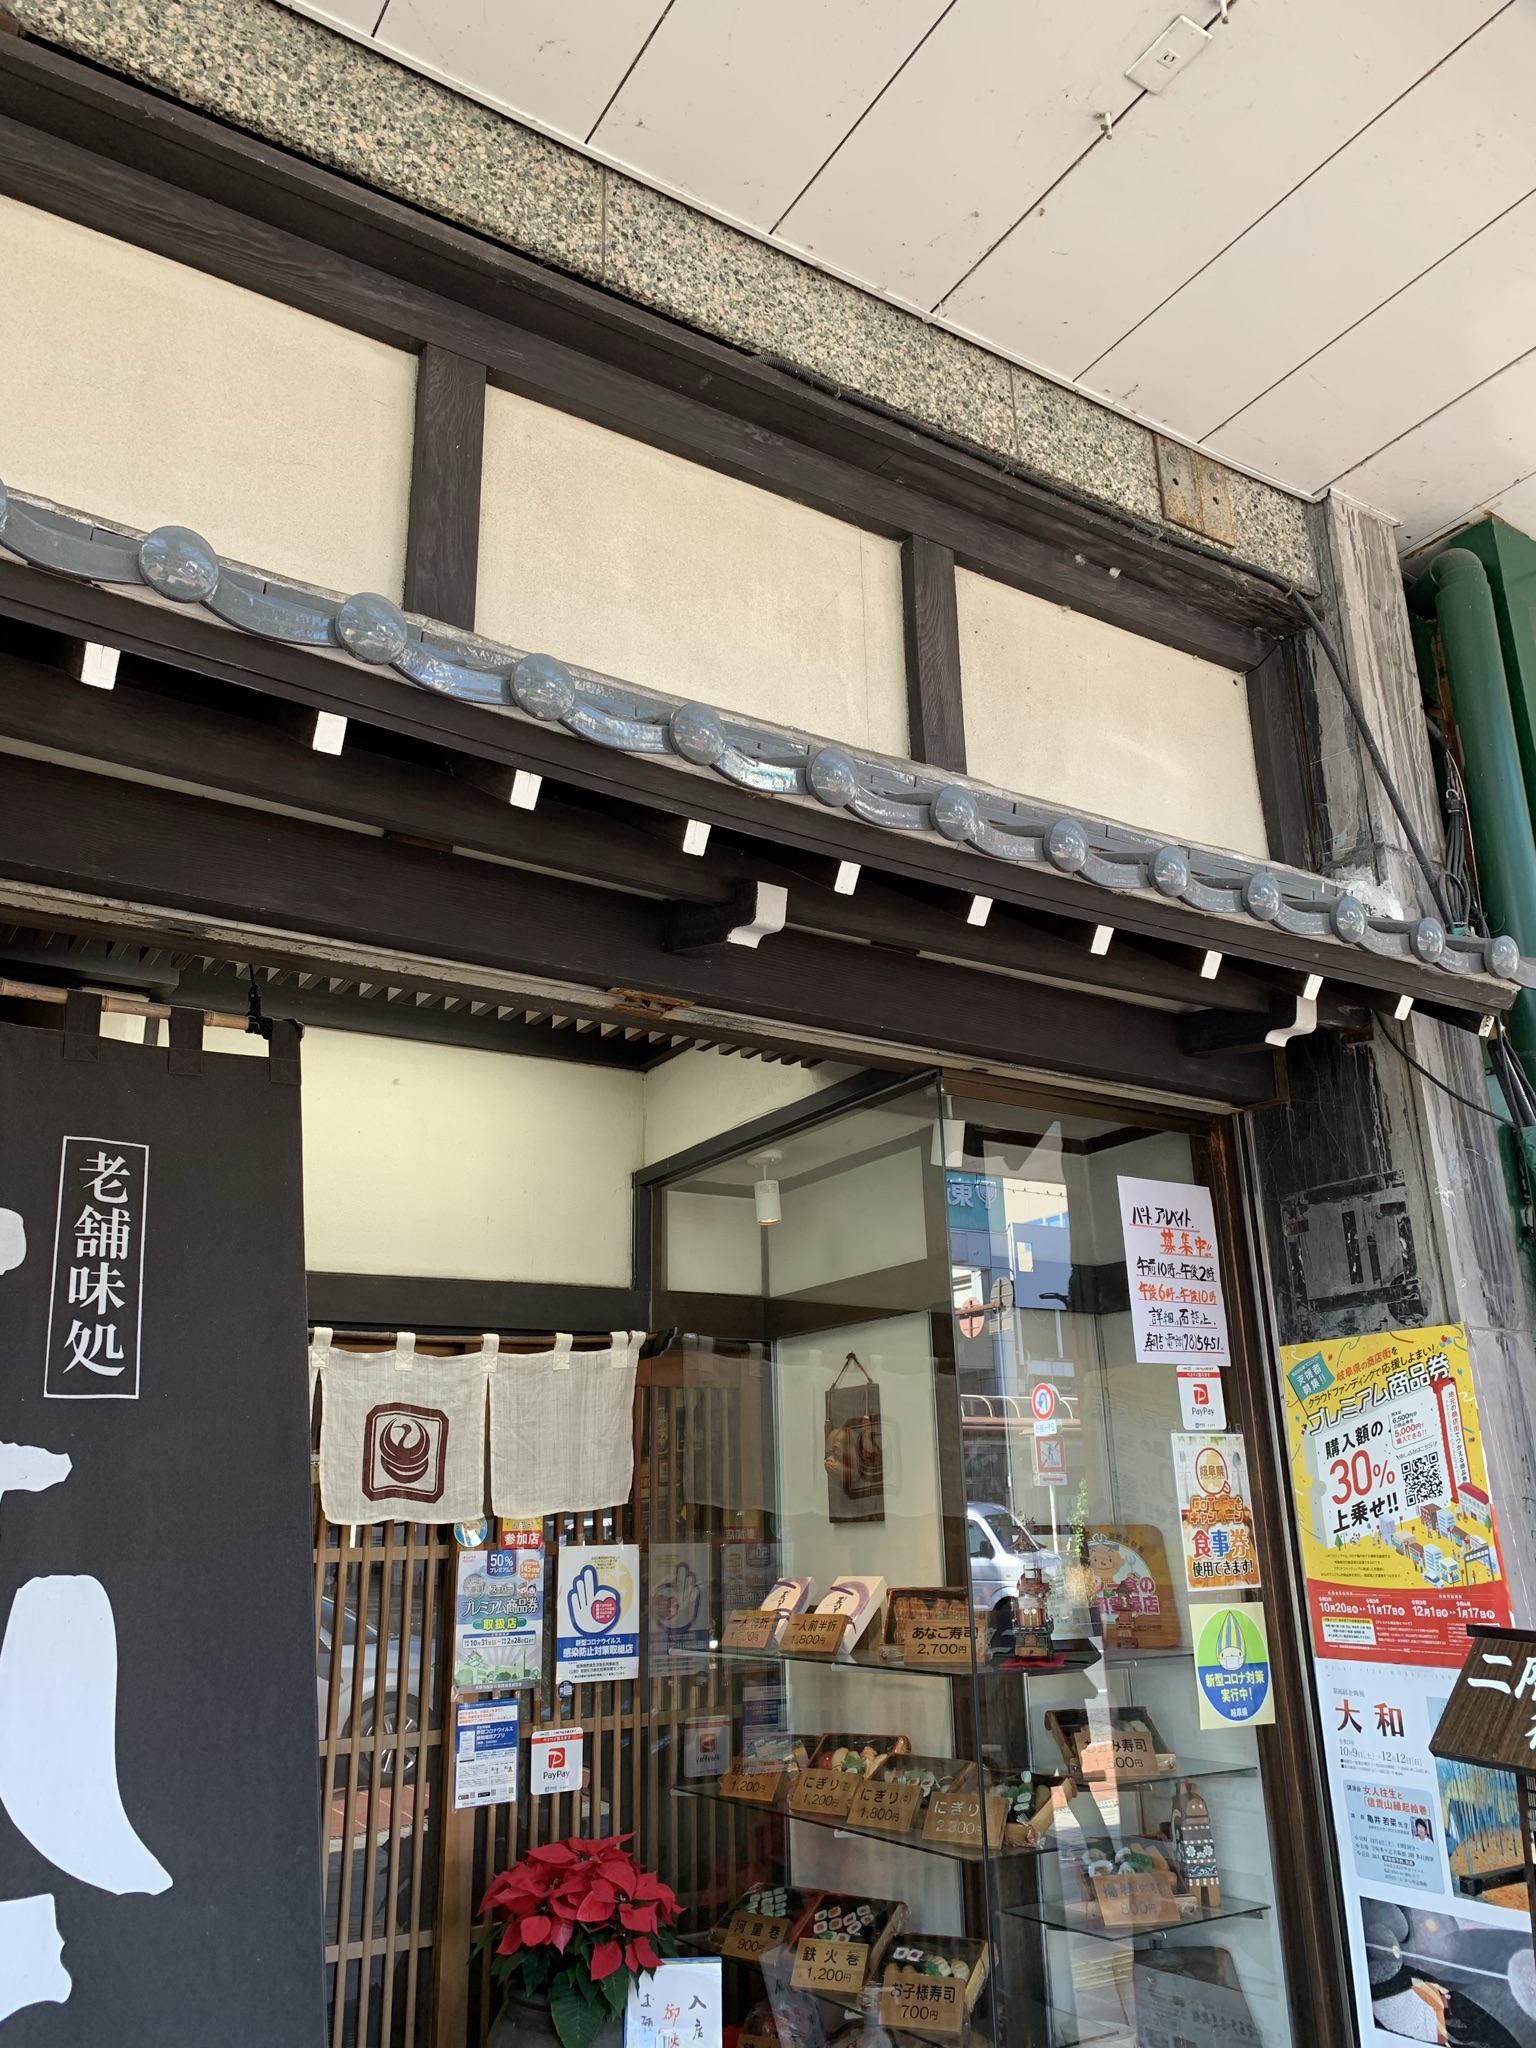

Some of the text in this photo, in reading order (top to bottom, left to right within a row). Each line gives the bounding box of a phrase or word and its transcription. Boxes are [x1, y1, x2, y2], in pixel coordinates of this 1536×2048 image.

[63, 1151, 131, 1377] 老舗味処
[1309, 1352, 1451, 1437] プレミアム商品券
[1192, 1407, 1214, 1417] PayPay
[1325, 1421, 1384, 1460] 購入額の
[1200, 1465, 1225, 1477] 岐阜県
[1329, 1449, 1396, 1505] 30%
[1190, 1510, 1244, 1524] キャンペーン
[504, 1532, 540, 1546] 参加店
[1192, 1529, 1249, 1558] 食事券
[490, 1554, 514, 1568] 50%
[1192, 1559, 1254, 1578] 使用できます!
[462, 1598, 539, 1617] プレミアム商品券
[483, 1618, 518, 1630] 取扱店
[912, 1626, 980, 1640] あなご寿司
[575, 1637, 621, 1646] 新型コロナウイルス
[917, 1643, 967, 1656] 2,700円
[562, 1644, 634, 1658] 感染防止対策取組店
[1205, 1670, 1265, 1688] 新型コロナ対策
[1220, 1687, 1253, 1703] 実行中!
[543, 1769, 570, 1780] PayPay
[860, 1806, 900, 1822] 1,800円
[734, 1920, 781, 1940] 河童巻
[737, 1938, 766, 1952] 900円
[802, 1946, 861, 1967] 鉄火巻
[806, 1967, 852, 1984] 1,200円
[890, 1981, 956, 2004] お子様寿司
[901, 2005, 939, 2021] 700円
